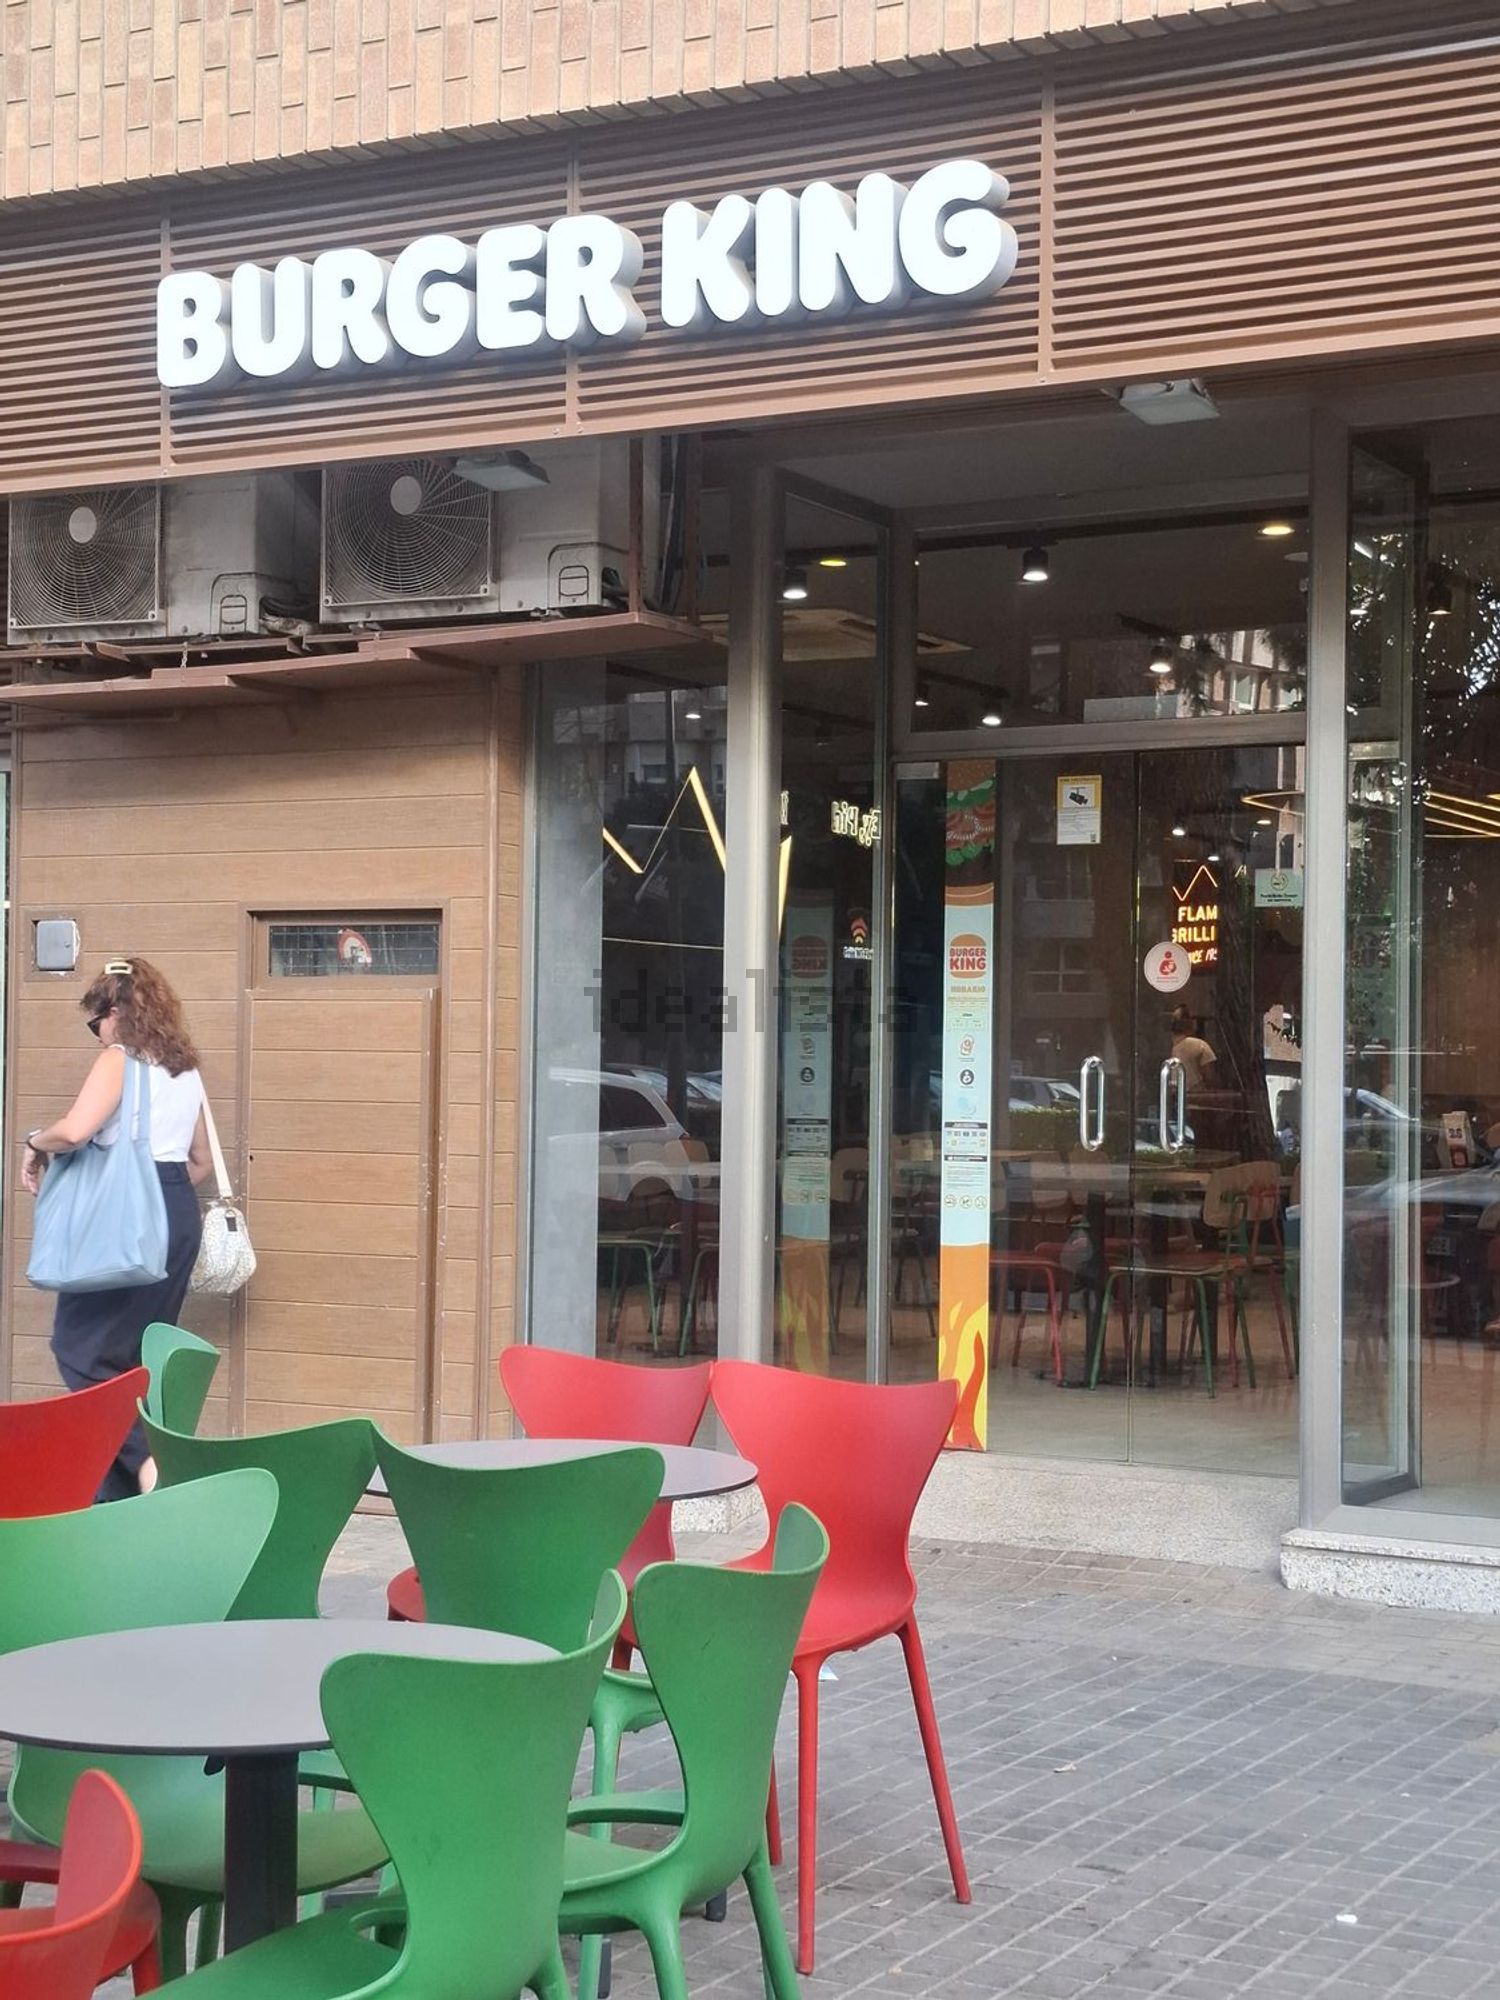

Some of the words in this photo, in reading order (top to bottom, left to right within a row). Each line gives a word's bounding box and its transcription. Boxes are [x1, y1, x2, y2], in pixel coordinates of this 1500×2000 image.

[157, 214, 646, 388] BURGER
[661, 158, 1019, 328] KING
[949, 947, 987, 957] BURGER
[949, 957, 986, 971] KING
